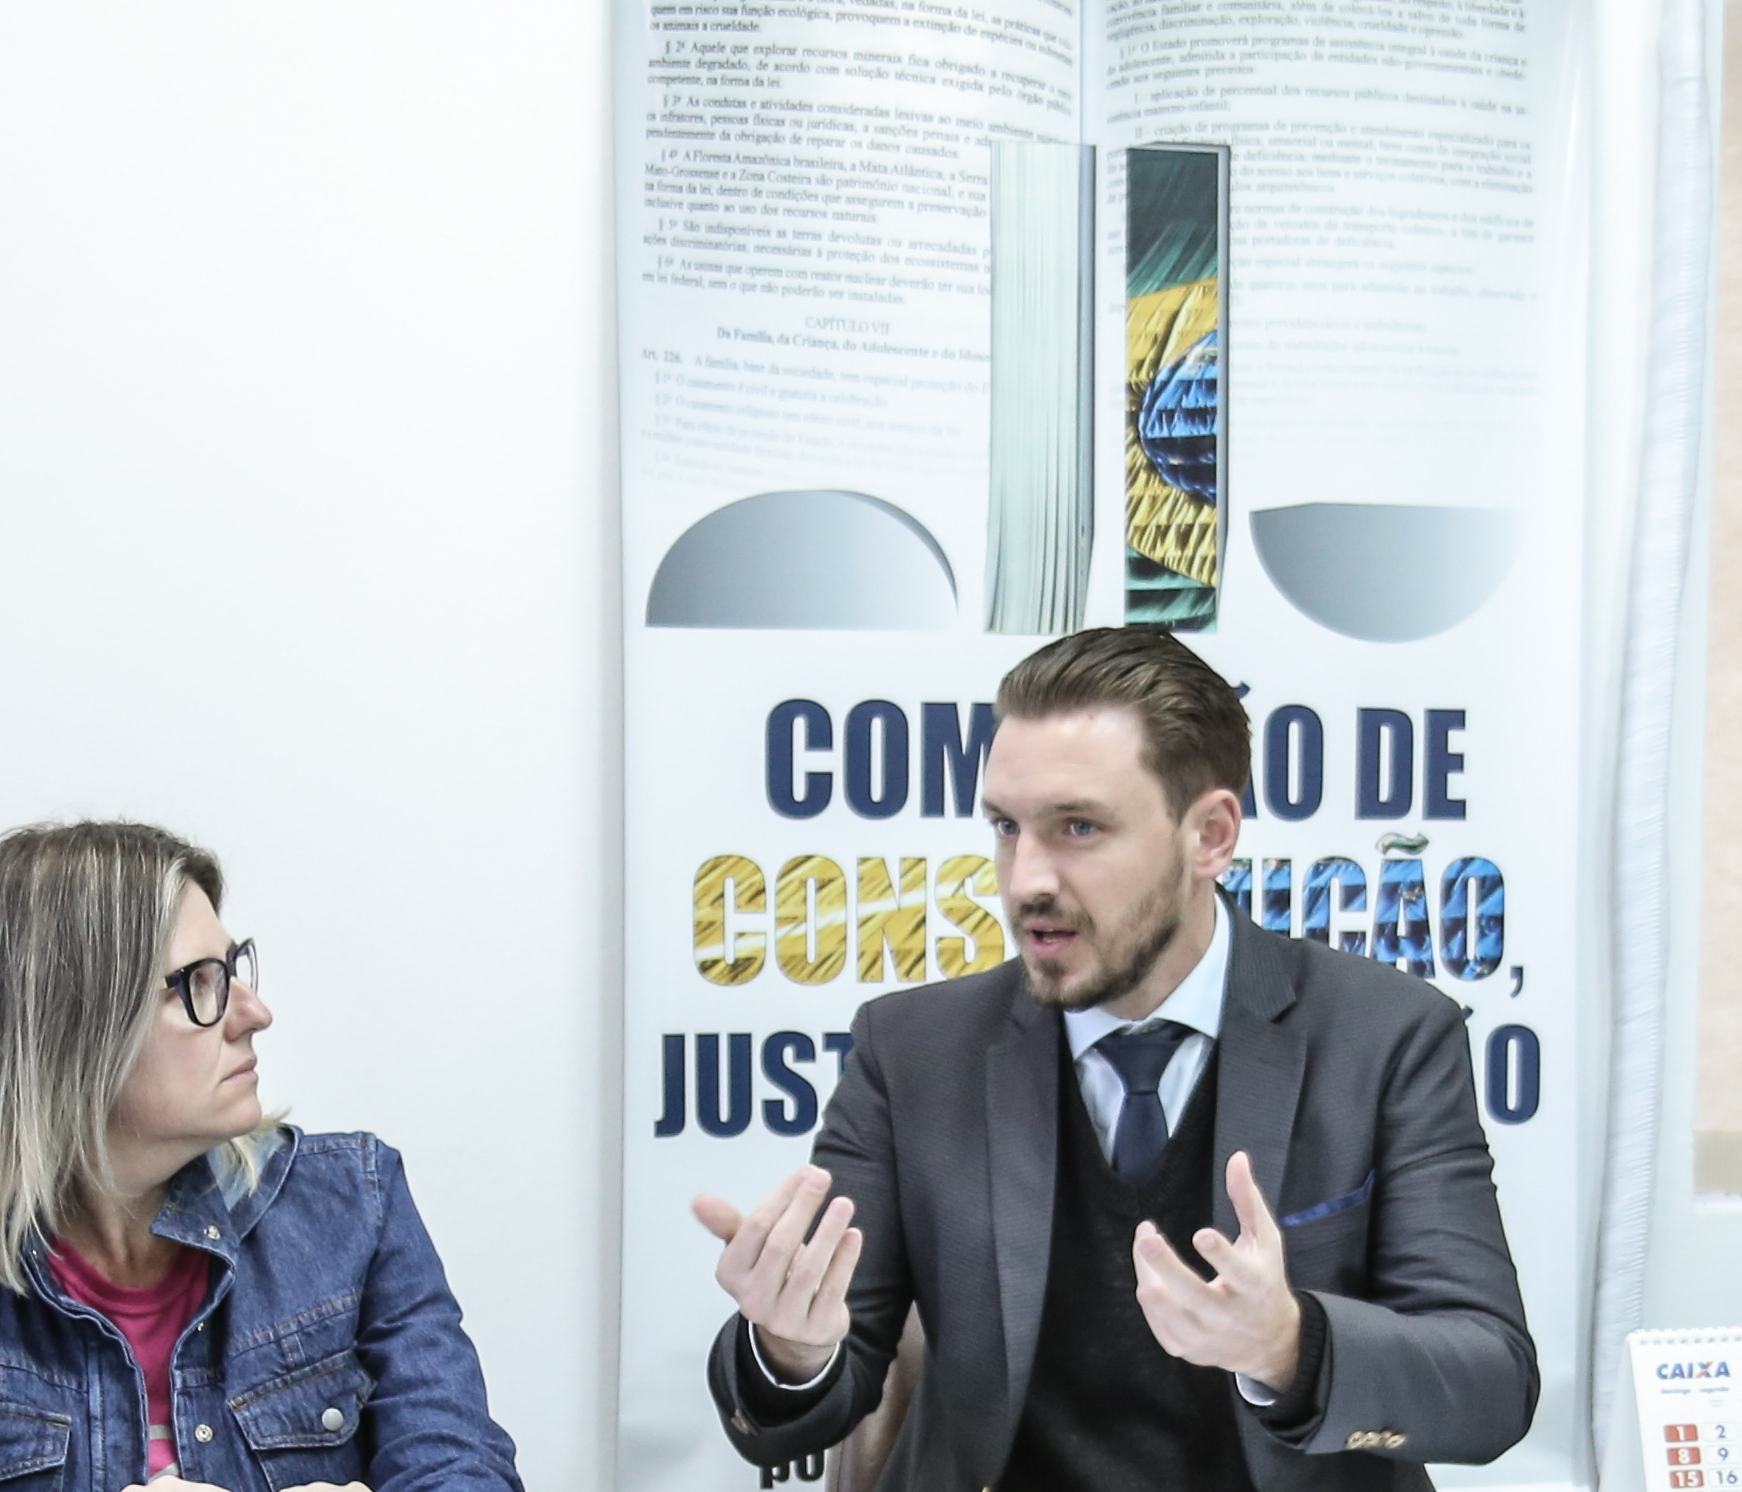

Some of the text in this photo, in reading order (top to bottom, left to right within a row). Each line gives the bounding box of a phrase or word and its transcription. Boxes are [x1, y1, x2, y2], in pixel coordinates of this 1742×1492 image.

[691, 42, 726, 56] Aquele
[730, 45, 748, 56] que
[753, 43, 797, 57] explorar
[802, 47, 848, 59] recursos
[853, 49, 902, 65] minerais
[908, 54, 929, 67] fica
[935, 58, 985, 76] obrigado
[695, 58, 751, 72] degradado,
[756, 60, 769, 71] de
[774, 61, 810, 73] acordo
[816, 65, 840, 75] com
[845, 66, 889, 81] solução
[895, 69, 936, 85] técnica
[942, 77, 983, 92] exigida
[988, 83, 1012, 96] pelo
[707, 77, 717, 86] na
[720, 75, 749, 86] forma
[753, 77, 764, 87] da
[659, 111, 707, 125] infratores,
[710, 114, 748, 126] pessoas
[753, 115, 785, 126] físicas
[789, 119, 803, 128] ou
[806, 118, 857, 133] jurídicas,
[874, 125, 918, 138] sanções
[922, 130, 959, 142] penais
[719, 130, 731, 141] da
[735, 130, 785, 145] obrigação
[789, 134, 802, 145] de
[806, 137, 846, 149] reparar
[850, 141, 863, 149] os
[867, 139, 900, 152] danos
[693, 151, 731, 163] Floresta
[733, 153, 790, 166] Amazônica
[793, 156, 847, 172] brasileira,
[859, 160, 888, 174] Mata
[891, 164, 946, 181] Atlântica,
[958, 170, 988, 185] Serra
[685, 183, 697, 194] da
[716, 185, 748, 197] dentro
[751, 188, 763, 198] de
[765, 188, 819, 204] condições
[822, 194, 842, 206] que
[845, 197, 904, 210] assegurem
[917, 202, 987, 218] preservação
[739, 169, 764, 181] Zona
[767, 171, 812, 185] Costeira
[815, 174, 833, 186] são
[836, 178, 898, 191] patrimônio
[902, 184, 954, 199] nacional,
[968, 192, 986, 201] sua
[804, 316, 889, 335] CAPÍTULO VII
[717, 327, 731, 340] Da
[777, 333, 790, 345] da
[792, 334, 840, 351] Criança,
[842, 339, 856, 351] do
[861, 341, 929, 358] Adolescente
[941, 349, 956, 360] do
[1355, 707, 1467, 820] DE
[1656, 1360, 1730, 1380] CAIXA
[1676, 1426, 1686, 1440] 1
[1715, 1425, 1726, 1439] 2
[1677, 1449, 1691, 1463] 8
[1718, 1448, 1728, 1462] 9
[1676, 1472, 1698, 1486] 15
[1717, 1470, 1737, 1484] 16
